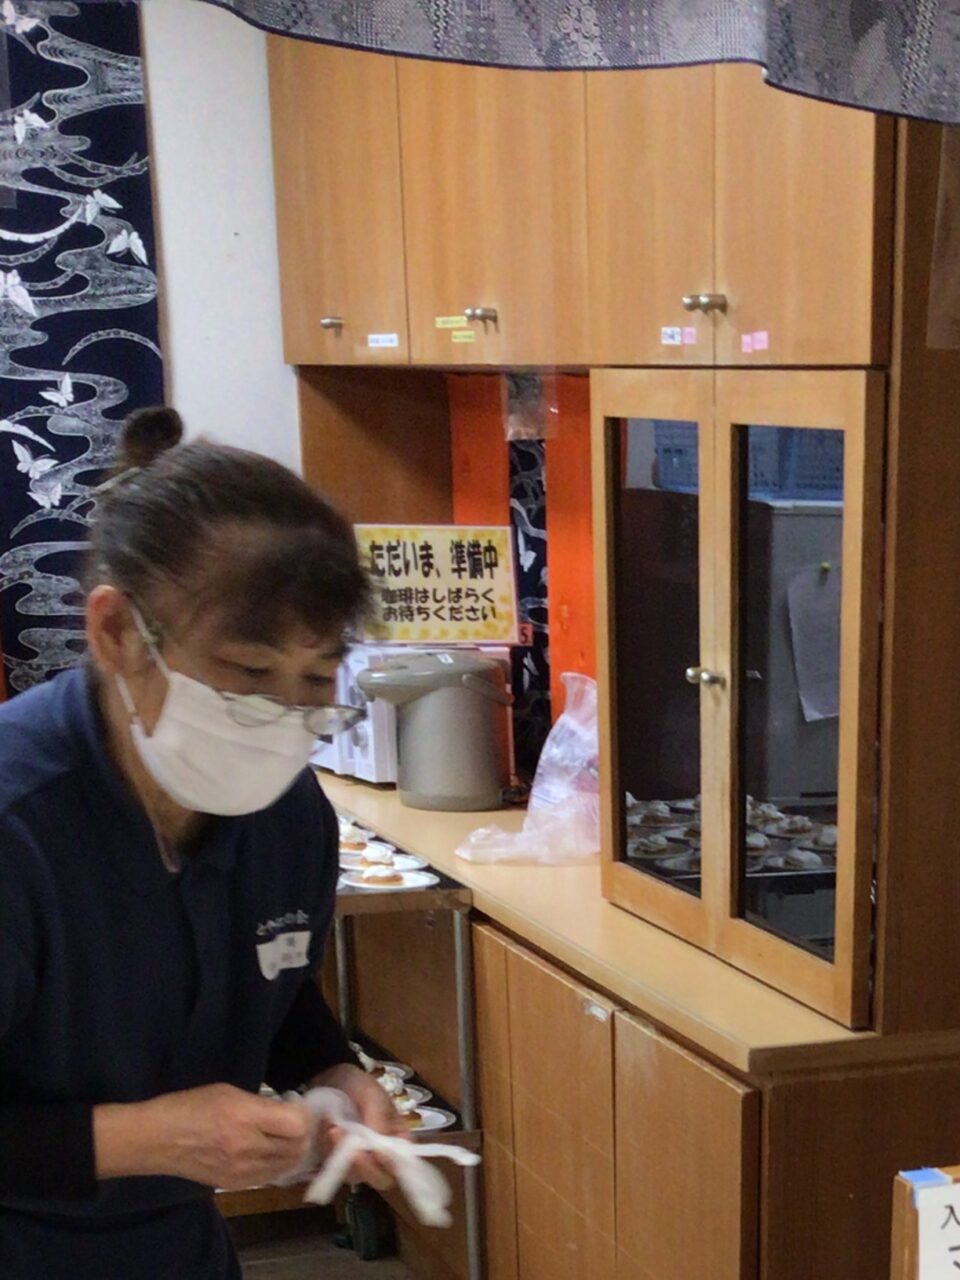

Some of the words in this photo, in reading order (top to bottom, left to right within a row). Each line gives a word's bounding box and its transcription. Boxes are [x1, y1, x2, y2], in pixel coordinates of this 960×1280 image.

[369, 538, 499, 579] ただいま、準備中
[383, 605, 497, 622] お待ちください
